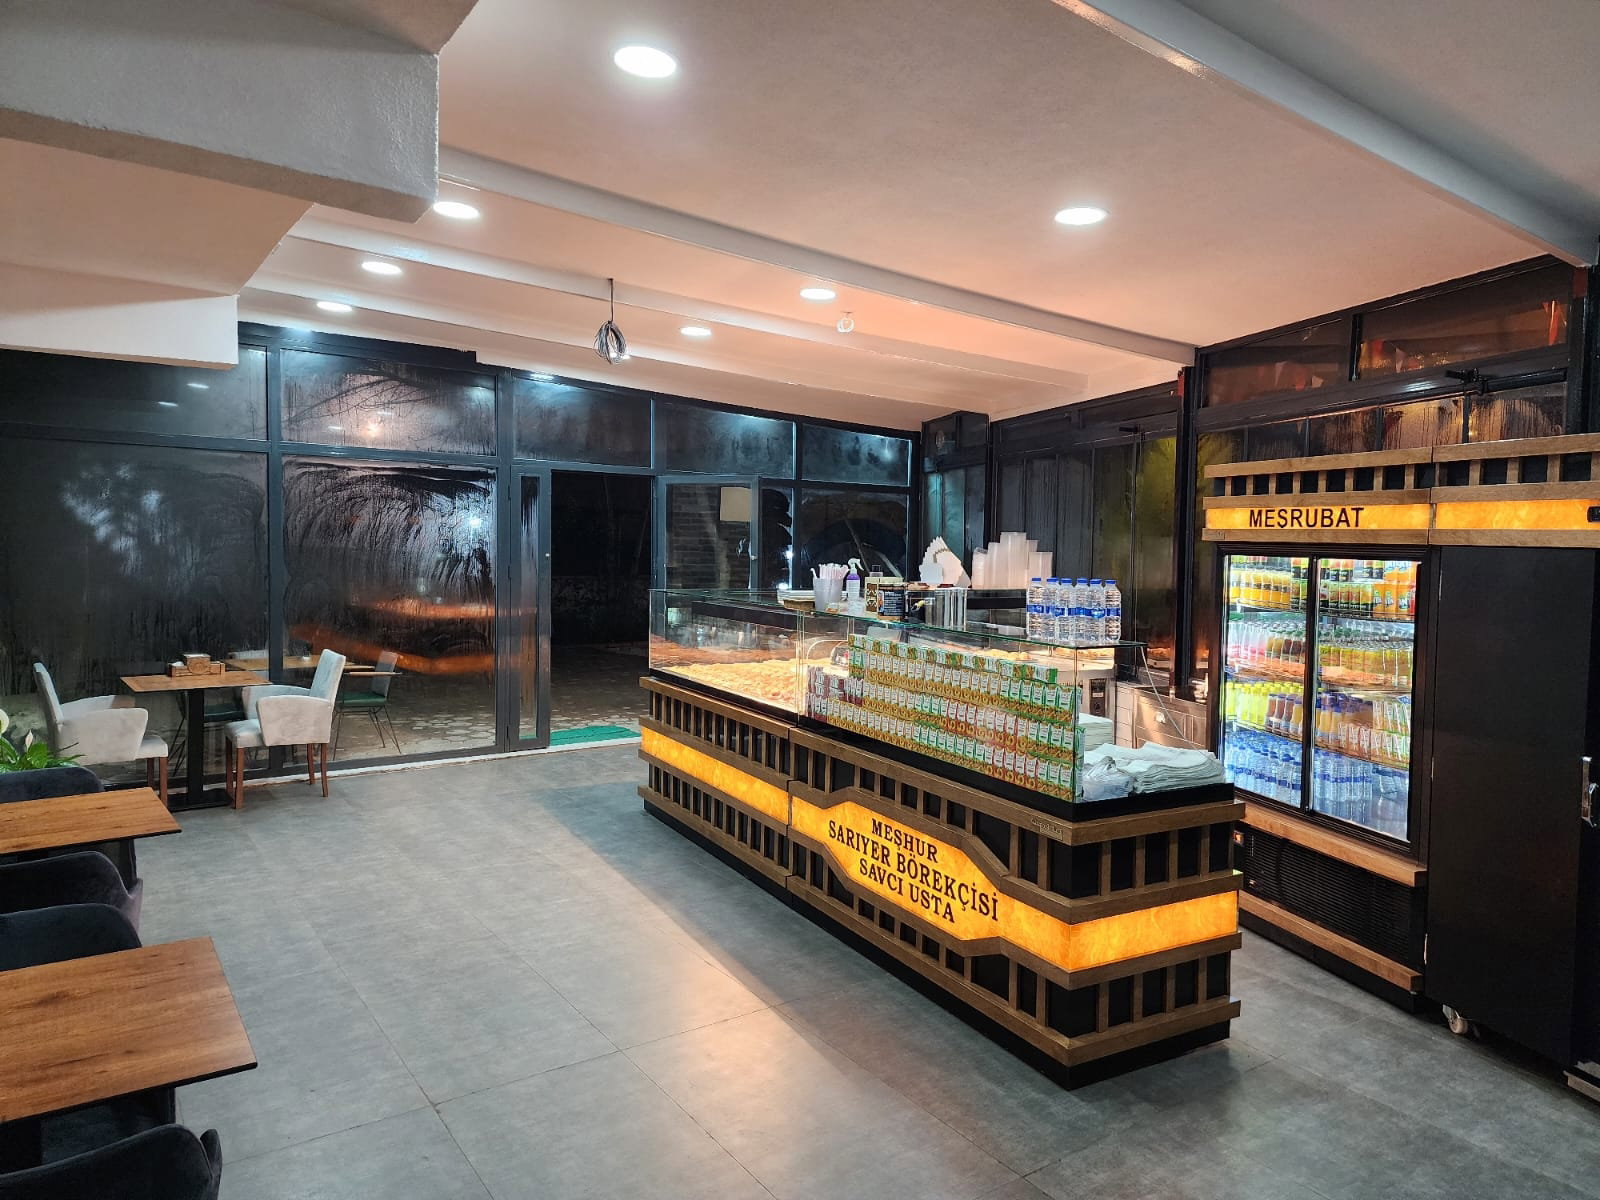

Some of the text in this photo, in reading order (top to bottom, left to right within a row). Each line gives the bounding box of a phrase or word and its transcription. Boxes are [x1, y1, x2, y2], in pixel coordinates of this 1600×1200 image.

[828, 820, 999, 921] SARIYER BÖREKÇİSİ
[871, 817, 938, 863] MEŞHUR
[859, 858, 955, 923] SAVCI USTA
